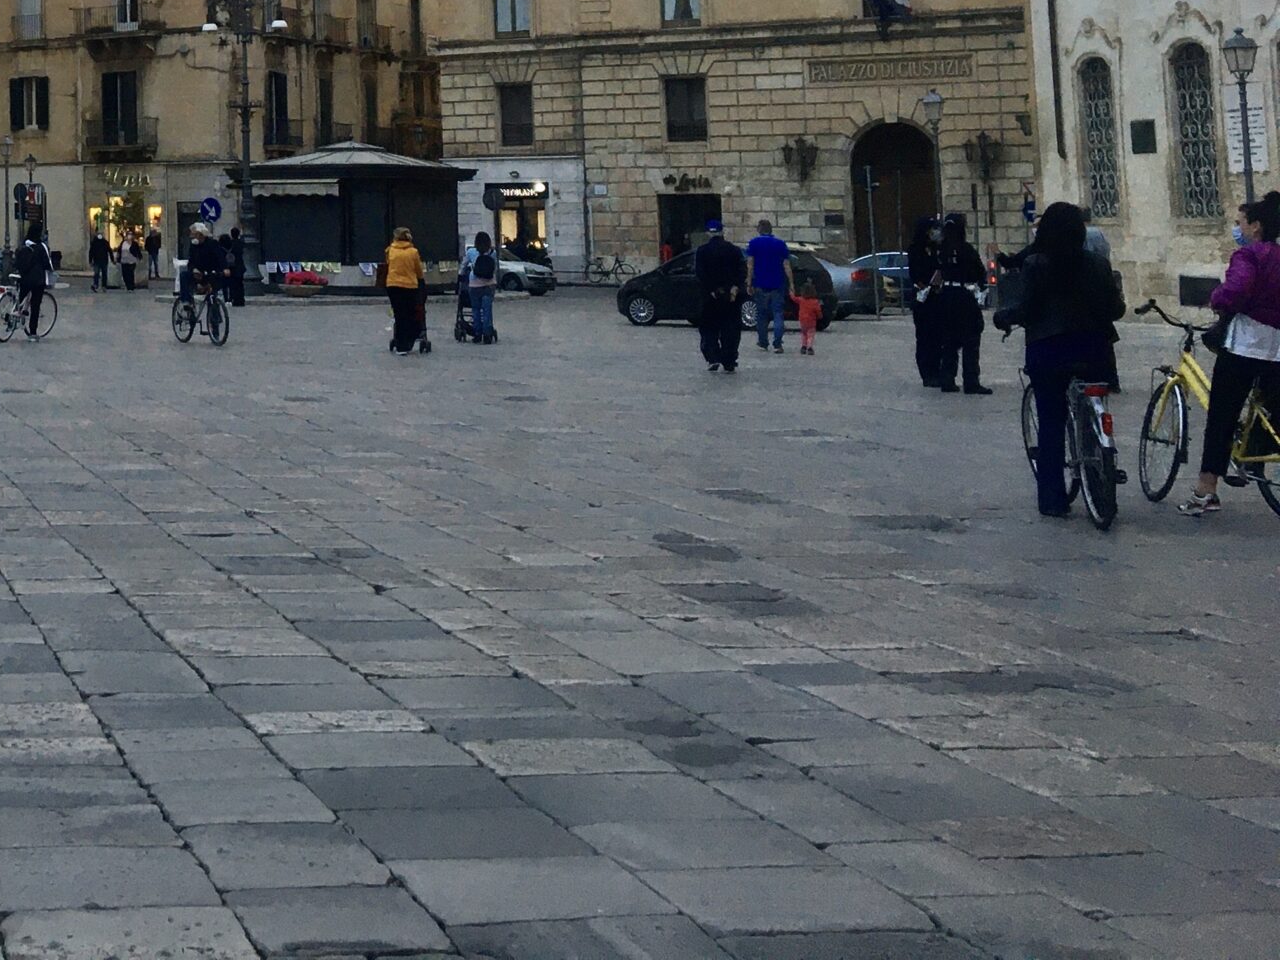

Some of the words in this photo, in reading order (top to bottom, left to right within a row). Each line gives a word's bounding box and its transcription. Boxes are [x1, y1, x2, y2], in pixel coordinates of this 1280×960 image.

[811, 62, 877, 82] PALAZZO
[881, 62, 894, 78] DI
[898, 59, 970, 77] GIUSTIZIA
